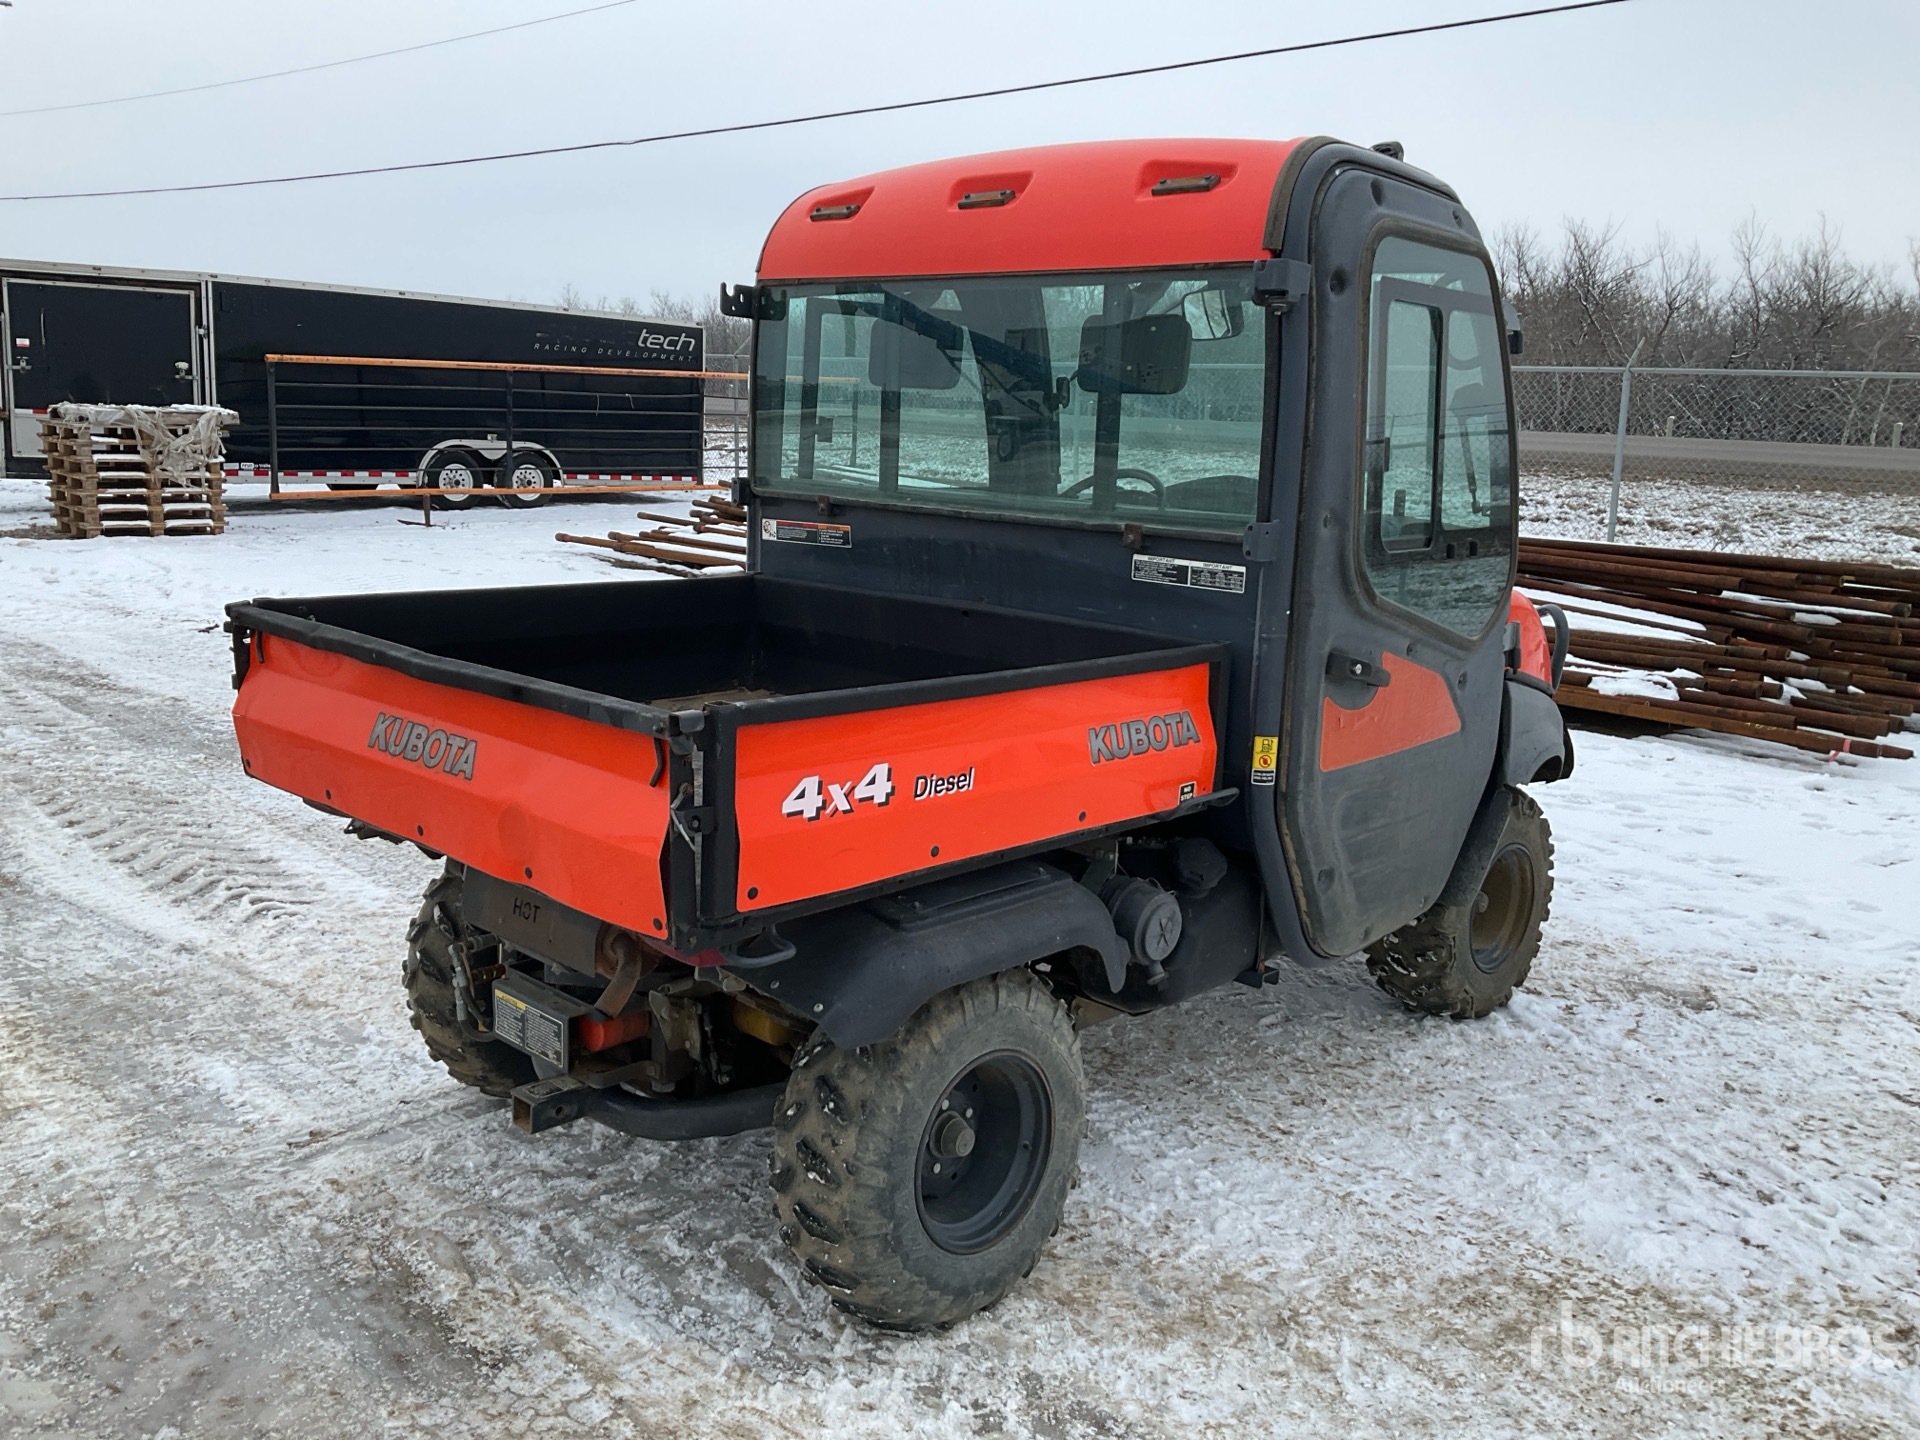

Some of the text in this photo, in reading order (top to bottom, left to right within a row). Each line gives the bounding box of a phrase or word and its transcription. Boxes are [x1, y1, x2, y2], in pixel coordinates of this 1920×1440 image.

[533, 343, 693, 362] RACING DEVELOPMENT
[637, 328, 696, 351] tech
[367, 712, 478, 781] KUBOTA
[1088, 711, 1200, 765] KUBOTA
[781, 762, 975, 822] 4x4 Diesel
[1183, 785, 1192, 793] NO
[512, 897, 541, 924] HOT
